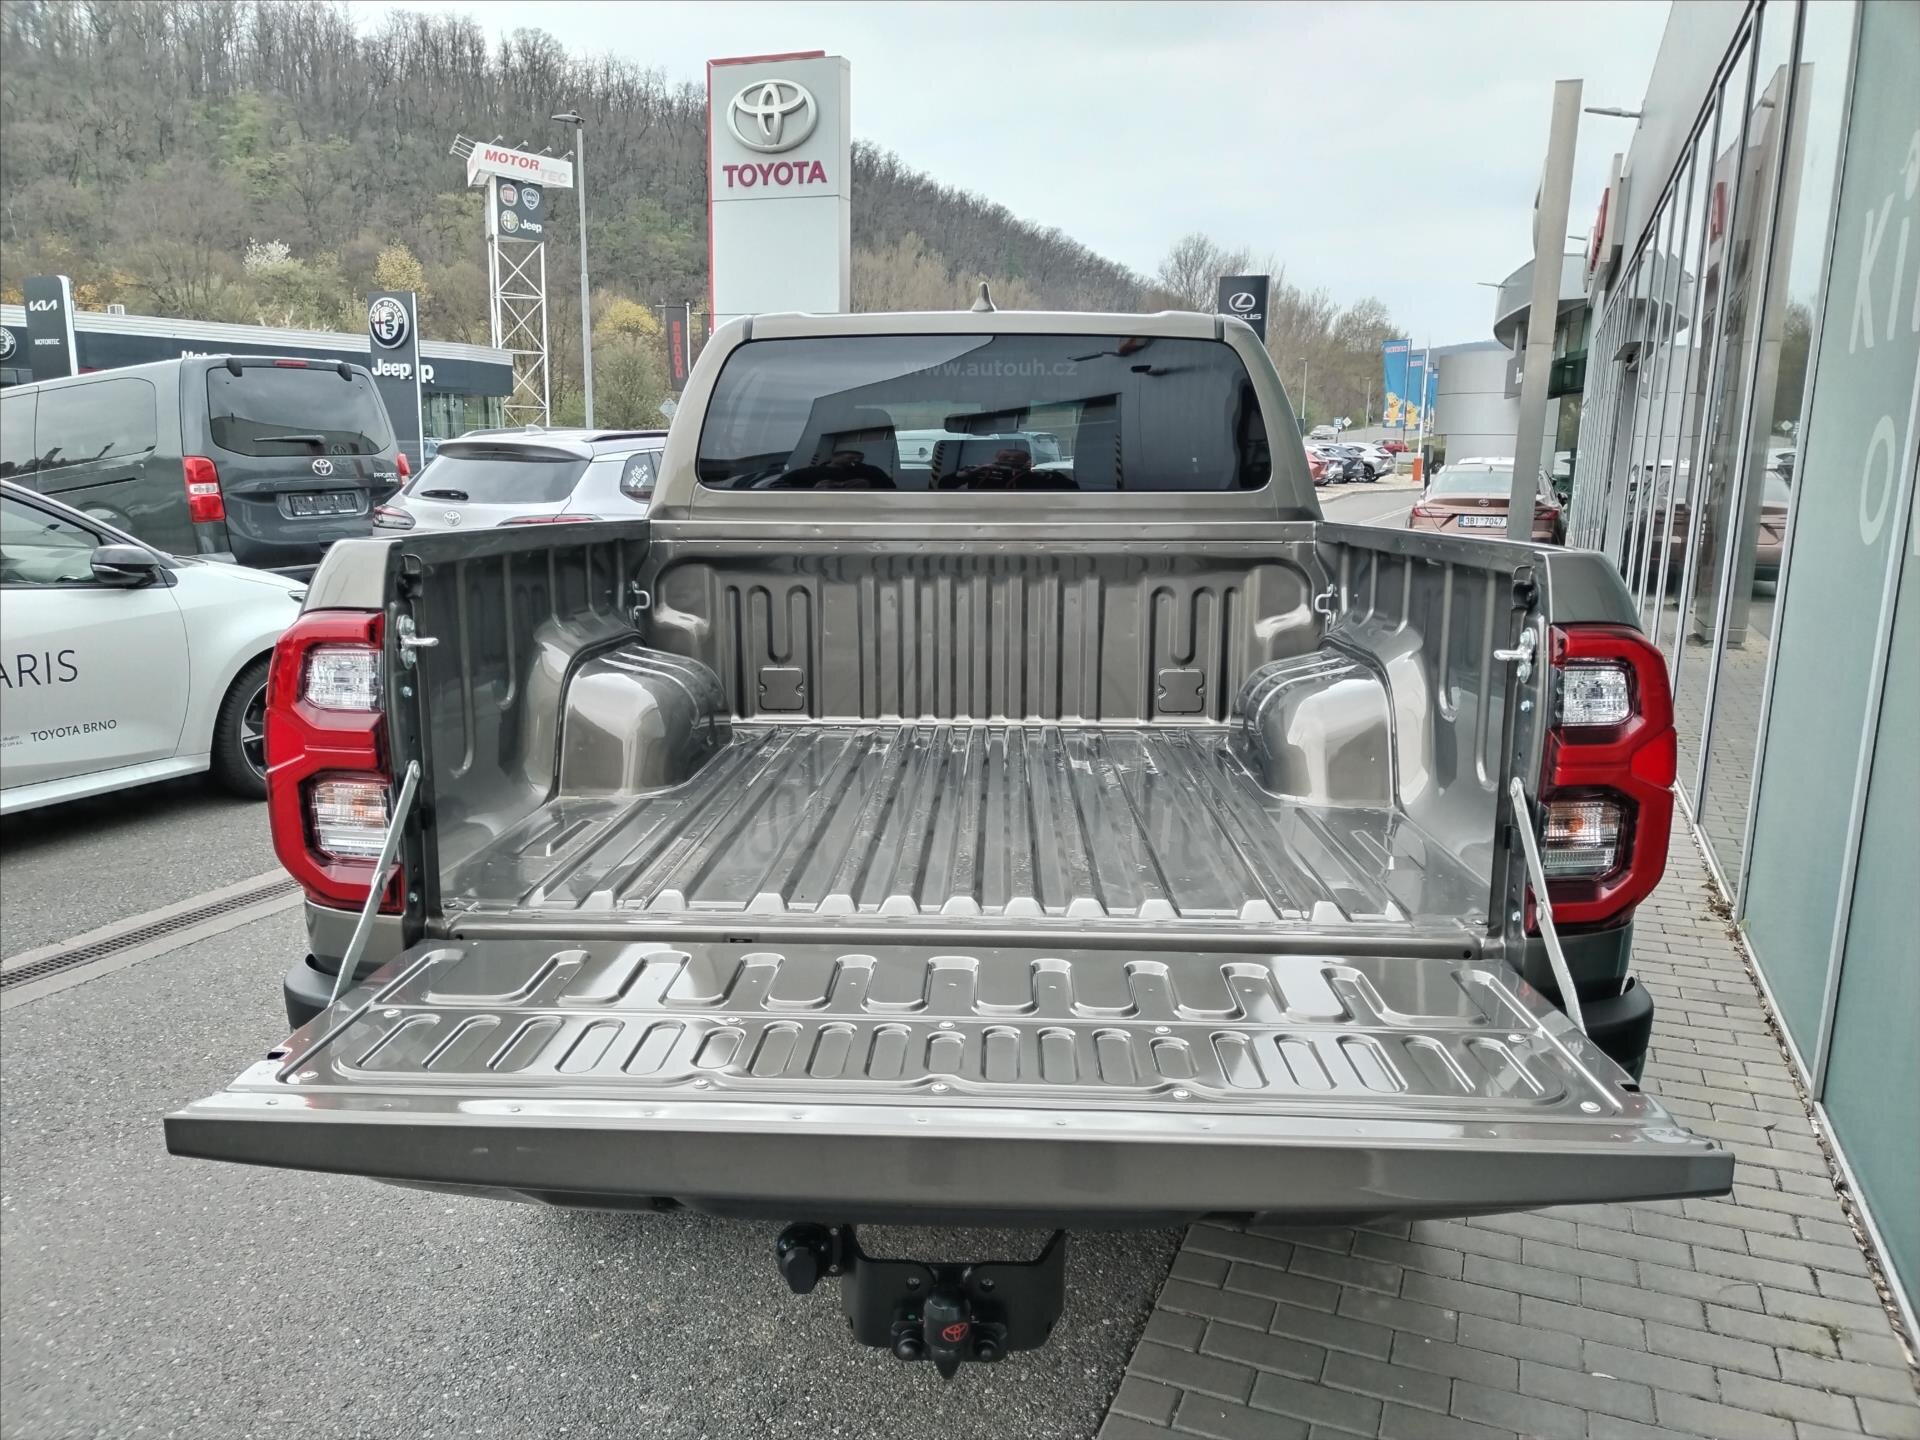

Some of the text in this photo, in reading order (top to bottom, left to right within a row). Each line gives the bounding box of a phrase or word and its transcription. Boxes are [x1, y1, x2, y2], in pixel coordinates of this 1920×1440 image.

[484, 149, 540, 171] MOTOR
[722, 160, 828, 188] TOYOTA
[520, 219, 542, 234] Jeep
[29, 299, 58, 312] KIA
[903, 357, 1078, 377] www.autouh.cz
[31, 725, 81, 742] TOYOTA
[83, 719, 117, 734] BRNO
